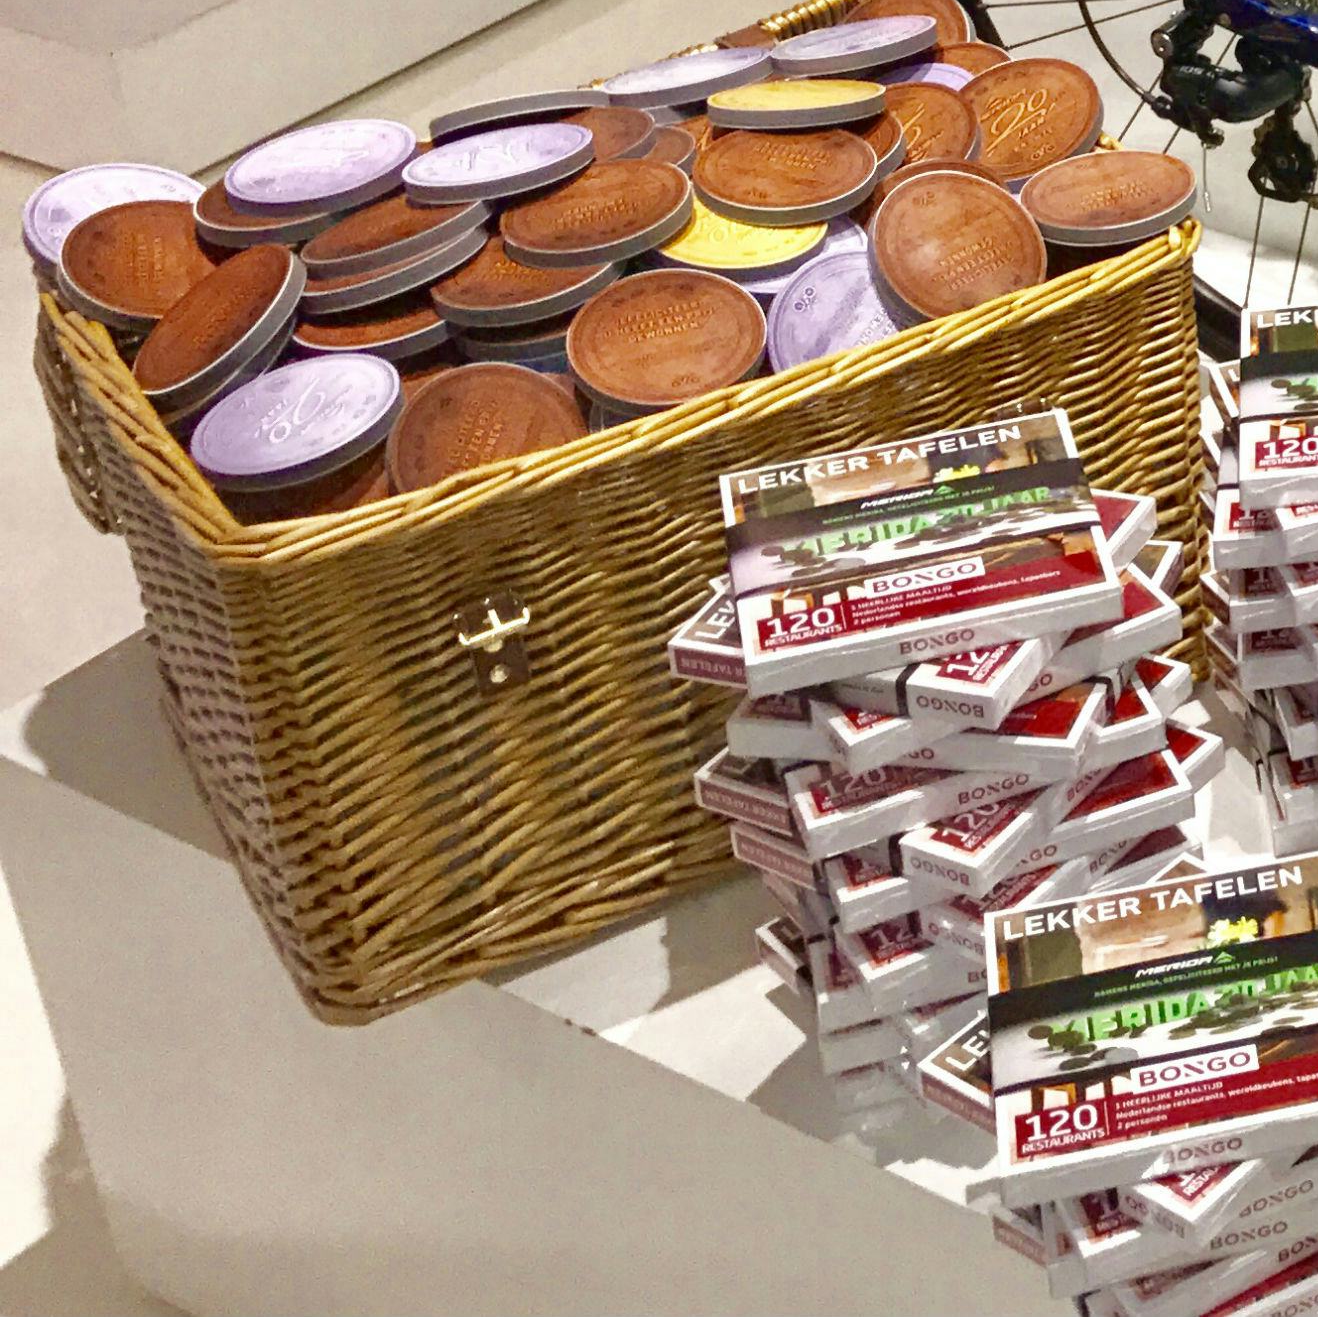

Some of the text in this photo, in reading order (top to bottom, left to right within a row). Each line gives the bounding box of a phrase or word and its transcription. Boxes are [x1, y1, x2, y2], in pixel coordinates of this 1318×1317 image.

[738, 425, 1022, 495] LEKKER TAFELEN
[873, 562, 978, 594] BONGO
[764, 623, 844, 647] RESTAURANTS
[766, 607, 836, 638] 120
[900, 628, 976, 656] BONGO
[916, 694, 986, 719] BONGO
[957, 774, 1029, 805] BONGO
[1003, 865, 1304, 941] LEKKER TAFELEN
[1135, 956, 1214, 979] MERIDA
[1138, 1052, 1252, 1088] BONGO
[1025, 1104, 1098, 1142] 120
[1022, 1128, 1106, 1154] RESTAURANTS
[1210, 1221, 1288, 1250] BONGO
